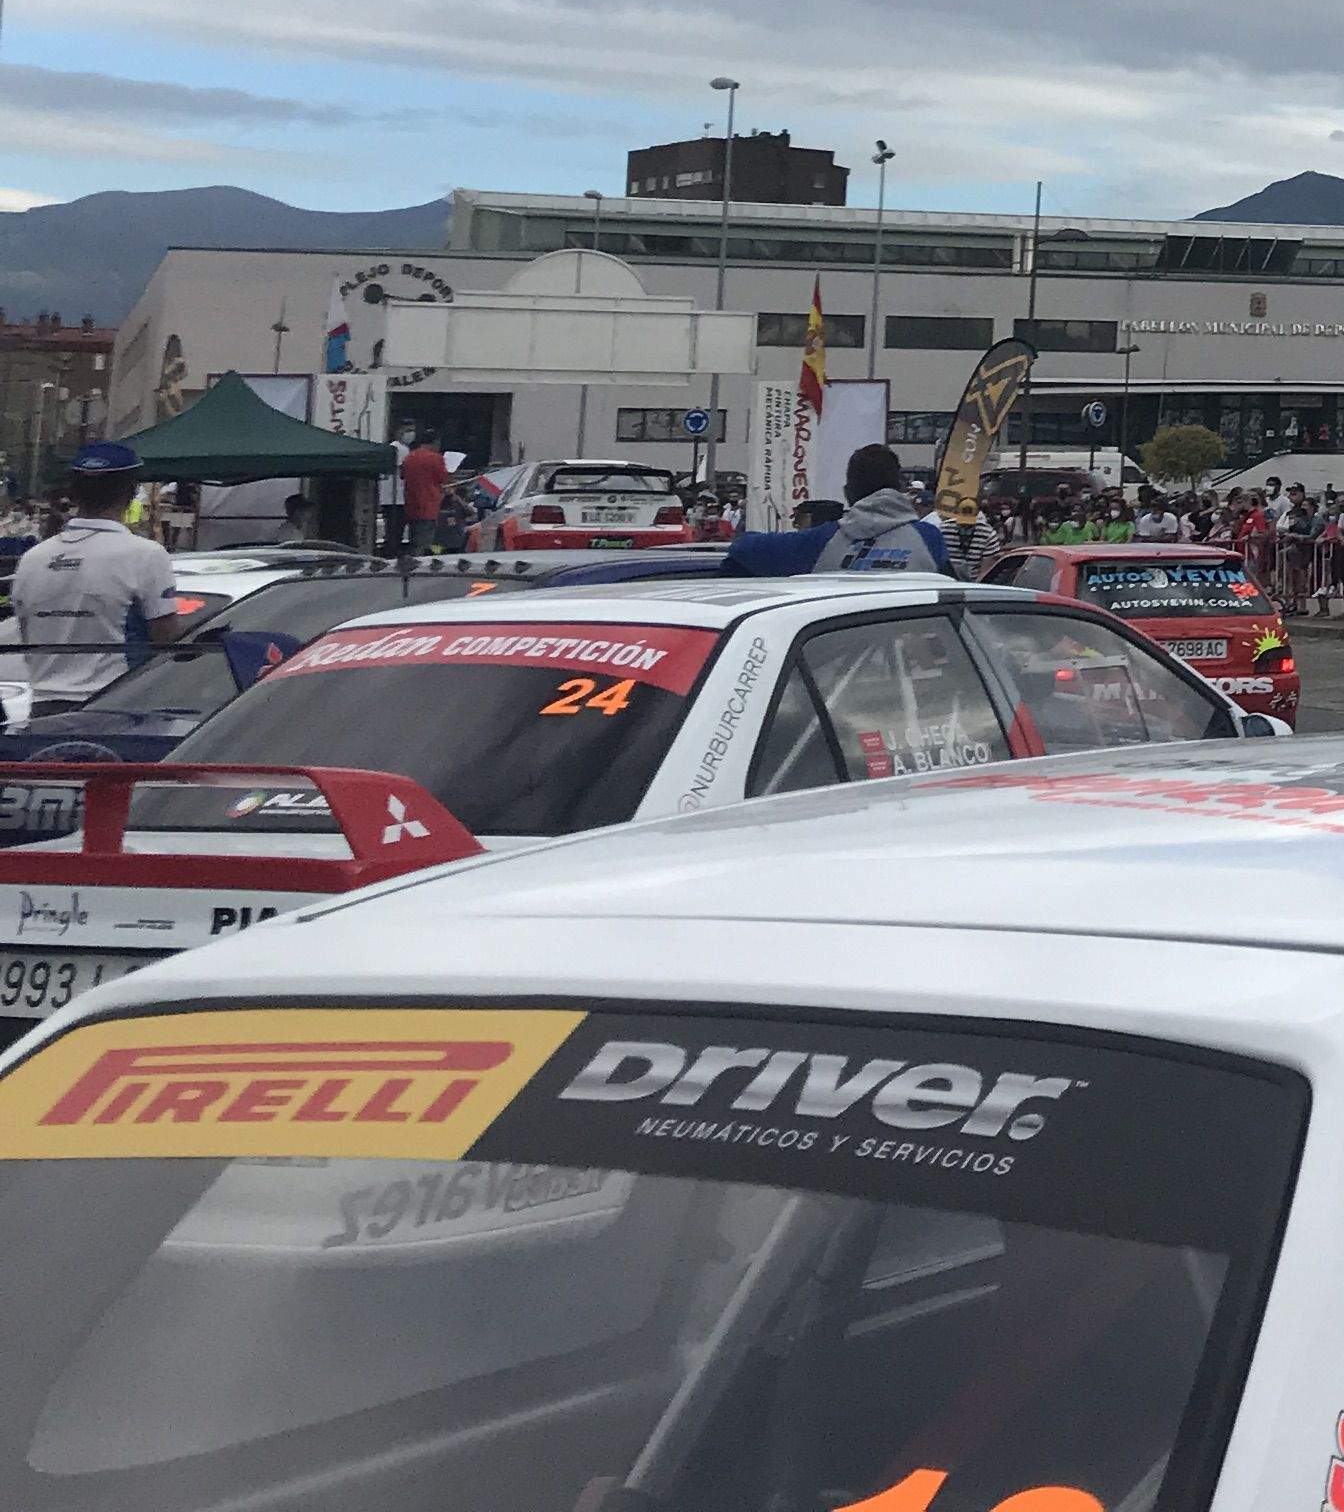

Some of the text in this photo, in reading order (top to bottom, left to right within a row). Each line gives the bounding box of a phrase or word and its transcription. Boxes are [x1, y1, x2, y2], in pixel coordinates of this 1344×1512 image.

[1204, 321, 1284, 337] MUNICIPAL
[1292, 323, 1309, 336] DE
[1087, 571, 1153, 585] AUTOS
[442, 639, 669, 671] COMPETICIÓN
[538, 678, 637, 716] 24
[0, 959, 78, 1010] 993
[37, 1040, 516, 1128] PIRELLI
[635, 1116, 1016, 1177] NEUMÁTICOS Y SERVICIOS
